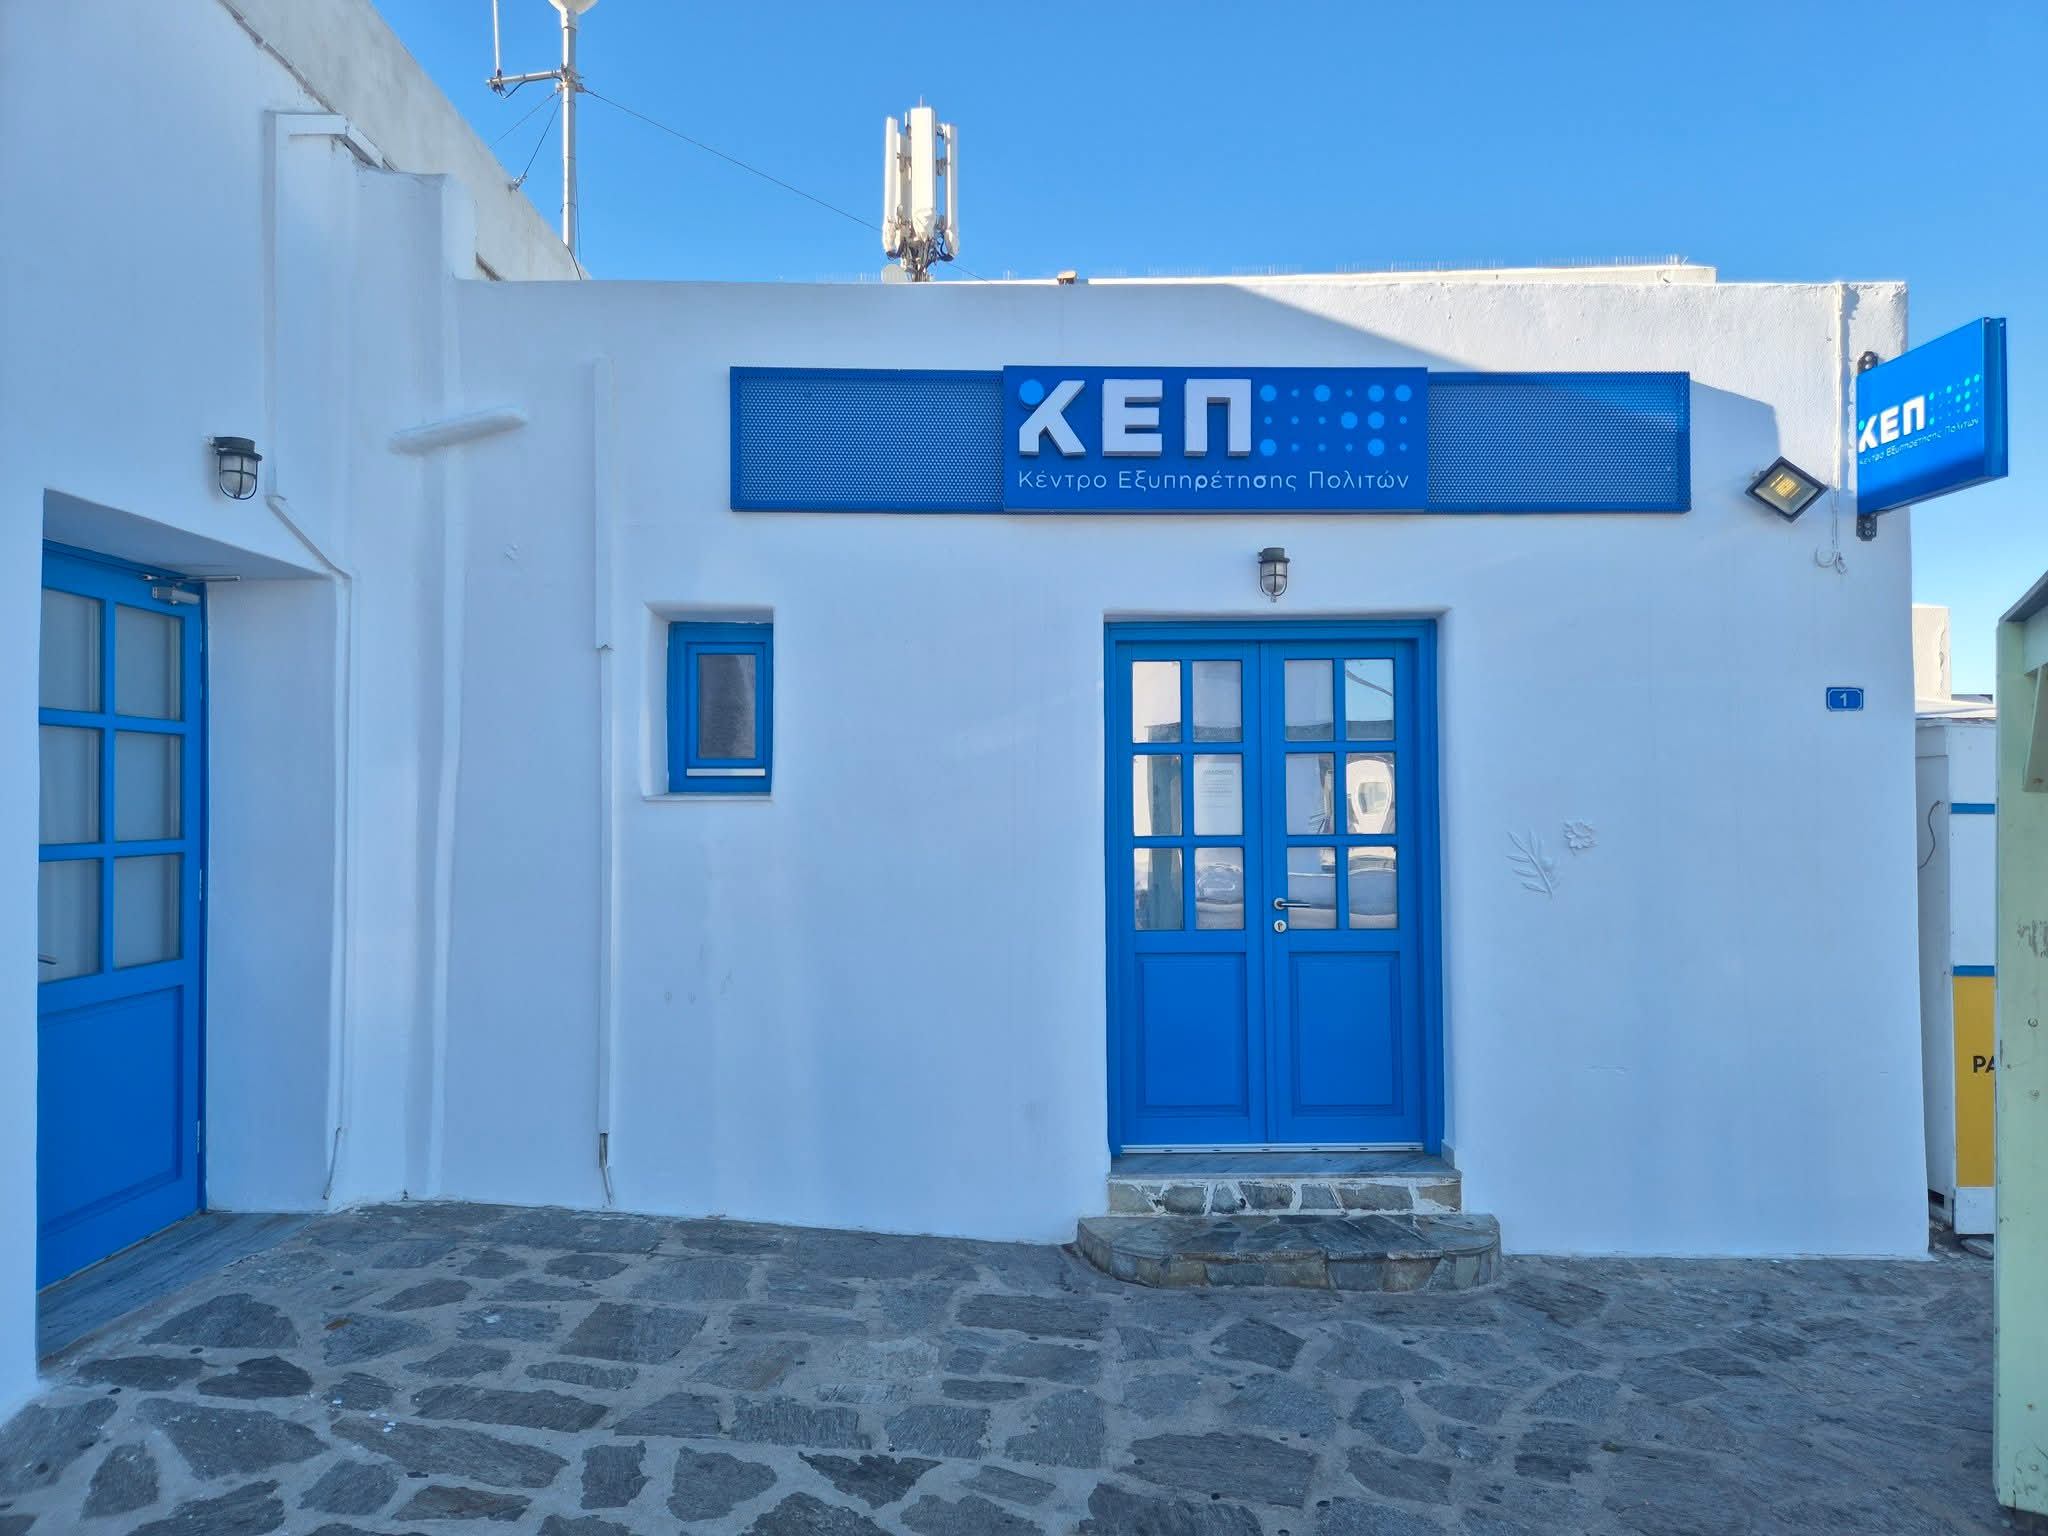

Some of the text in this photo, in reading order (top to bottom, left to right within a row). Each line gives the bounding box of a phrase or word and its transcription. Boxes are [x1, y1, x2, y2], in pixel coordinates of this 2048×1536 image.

[1018, 378, 1252, 458] ΚΕΠ
[1858, 394, 1926, 454] ΚΕΠ
[1018, 469, 1410, 492] Κέντρο Εξυπηρέτησης Πολιτών
[1840, 692, 1848, 707] 1
